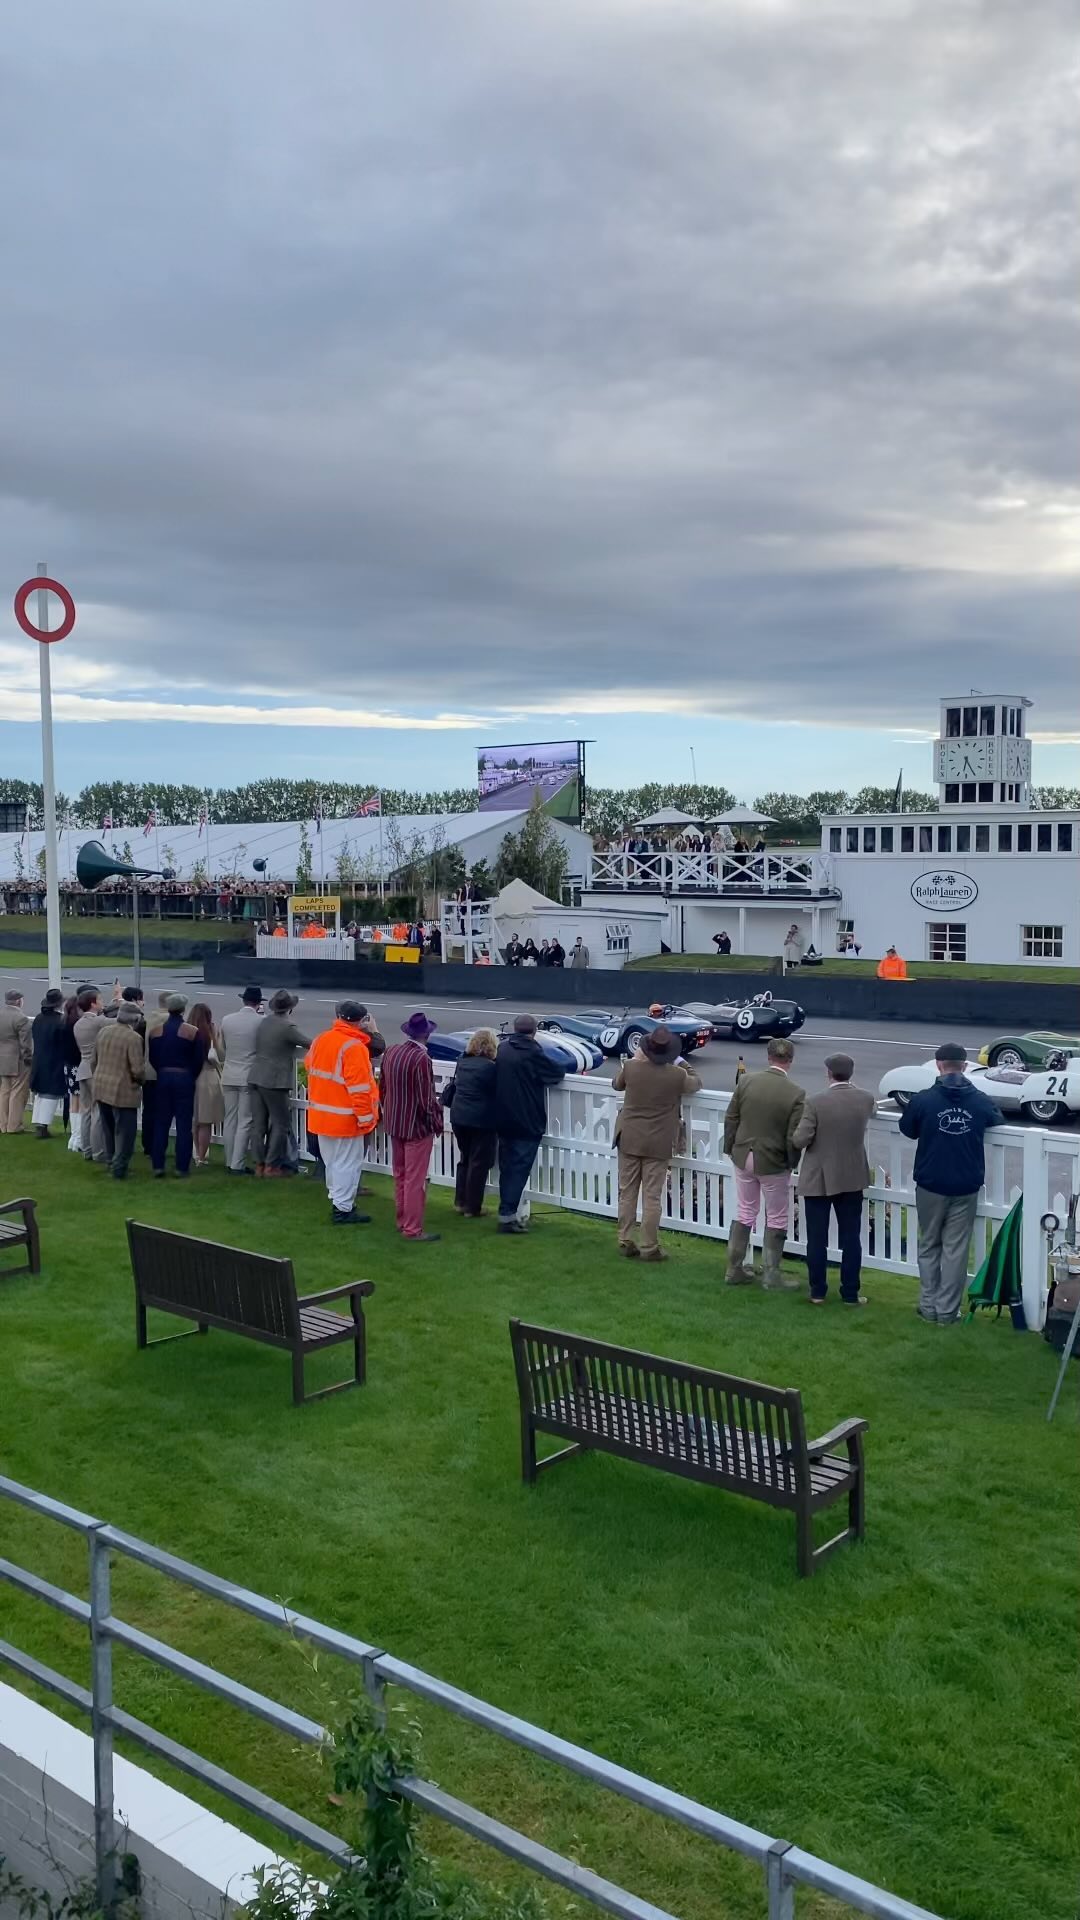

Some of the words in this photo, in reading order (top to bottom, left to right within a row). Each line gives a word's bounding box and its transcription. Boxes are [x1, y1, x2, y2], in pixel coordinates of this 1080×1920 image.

[916, 887, 940, 898] Ralph
[939, 885, 973, 900] Lauren
[740, 1011, 750, 1027] 5
[603, 1031, 616, 1044] 17
[1046, 1076, 1069, 1097] 24
